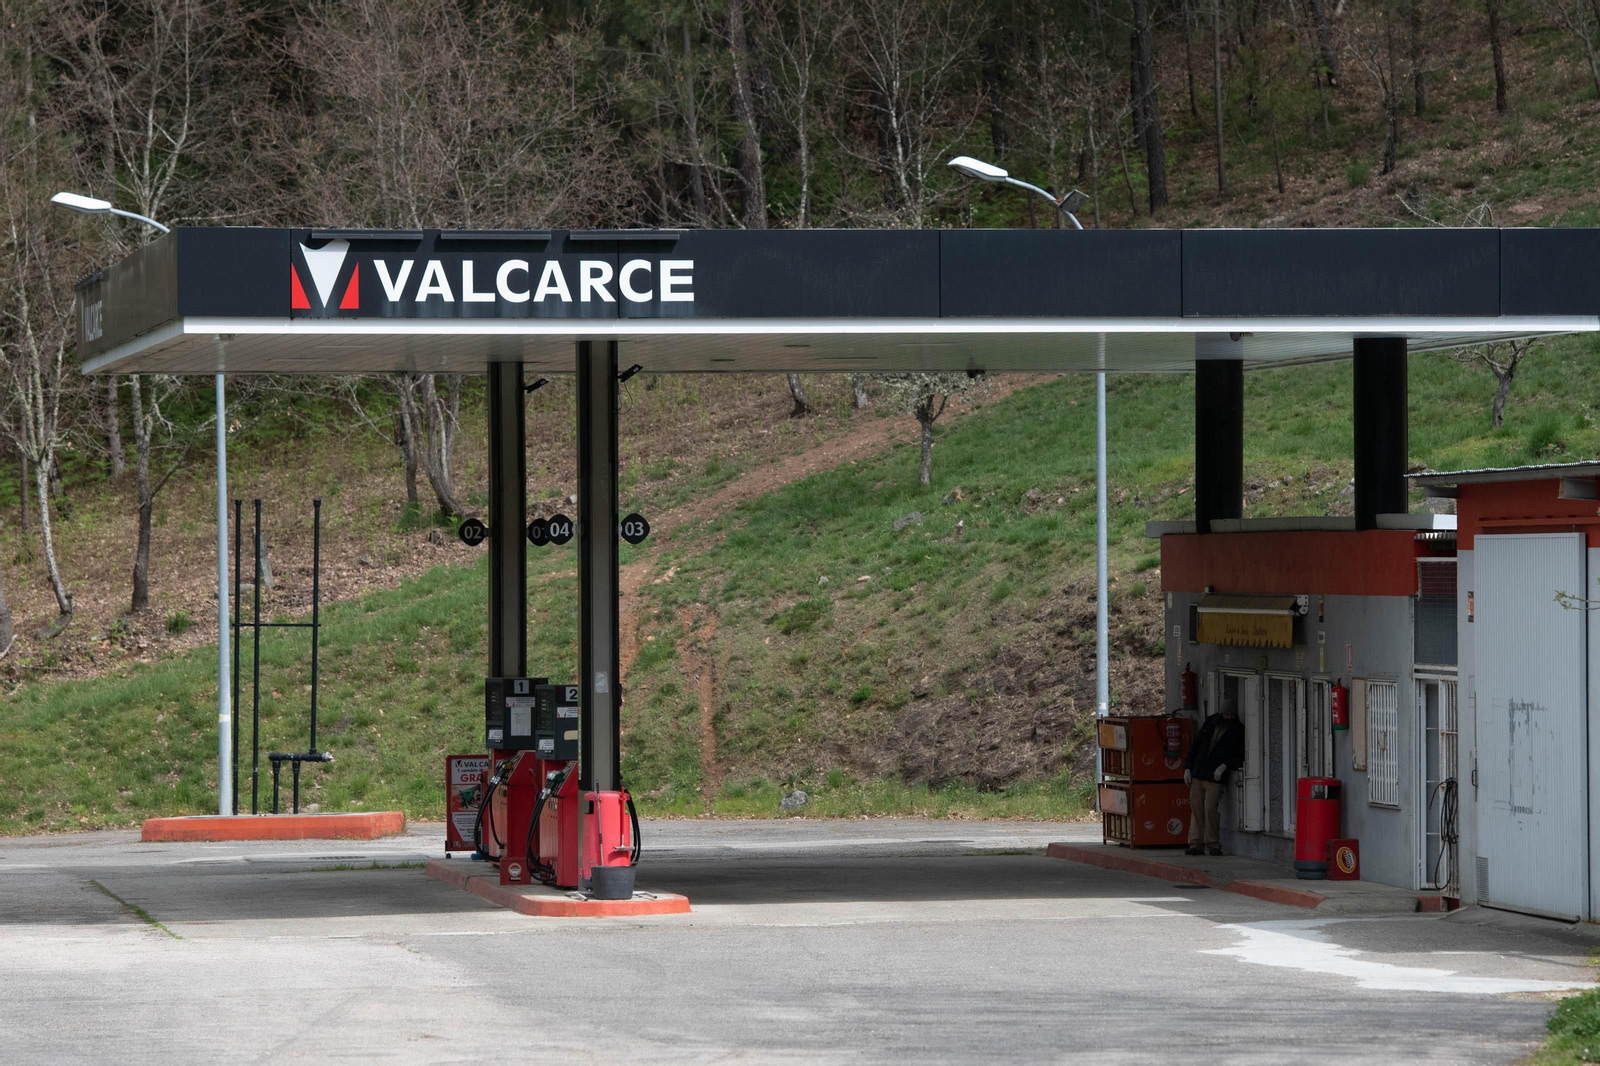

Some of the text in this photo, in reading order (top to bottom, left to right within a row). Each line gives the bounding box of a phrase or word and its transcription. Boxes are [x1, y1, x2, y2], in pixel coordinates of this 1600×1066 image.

[373, 259, 695, 303] VALCARCE
[464, 525, 481, 539] 02
[549, 522, 570, 537] 04
[624, 521, 644, 536] 03
[518, 681, 524, 692] 1
[569, 688, 578, 700] 2
